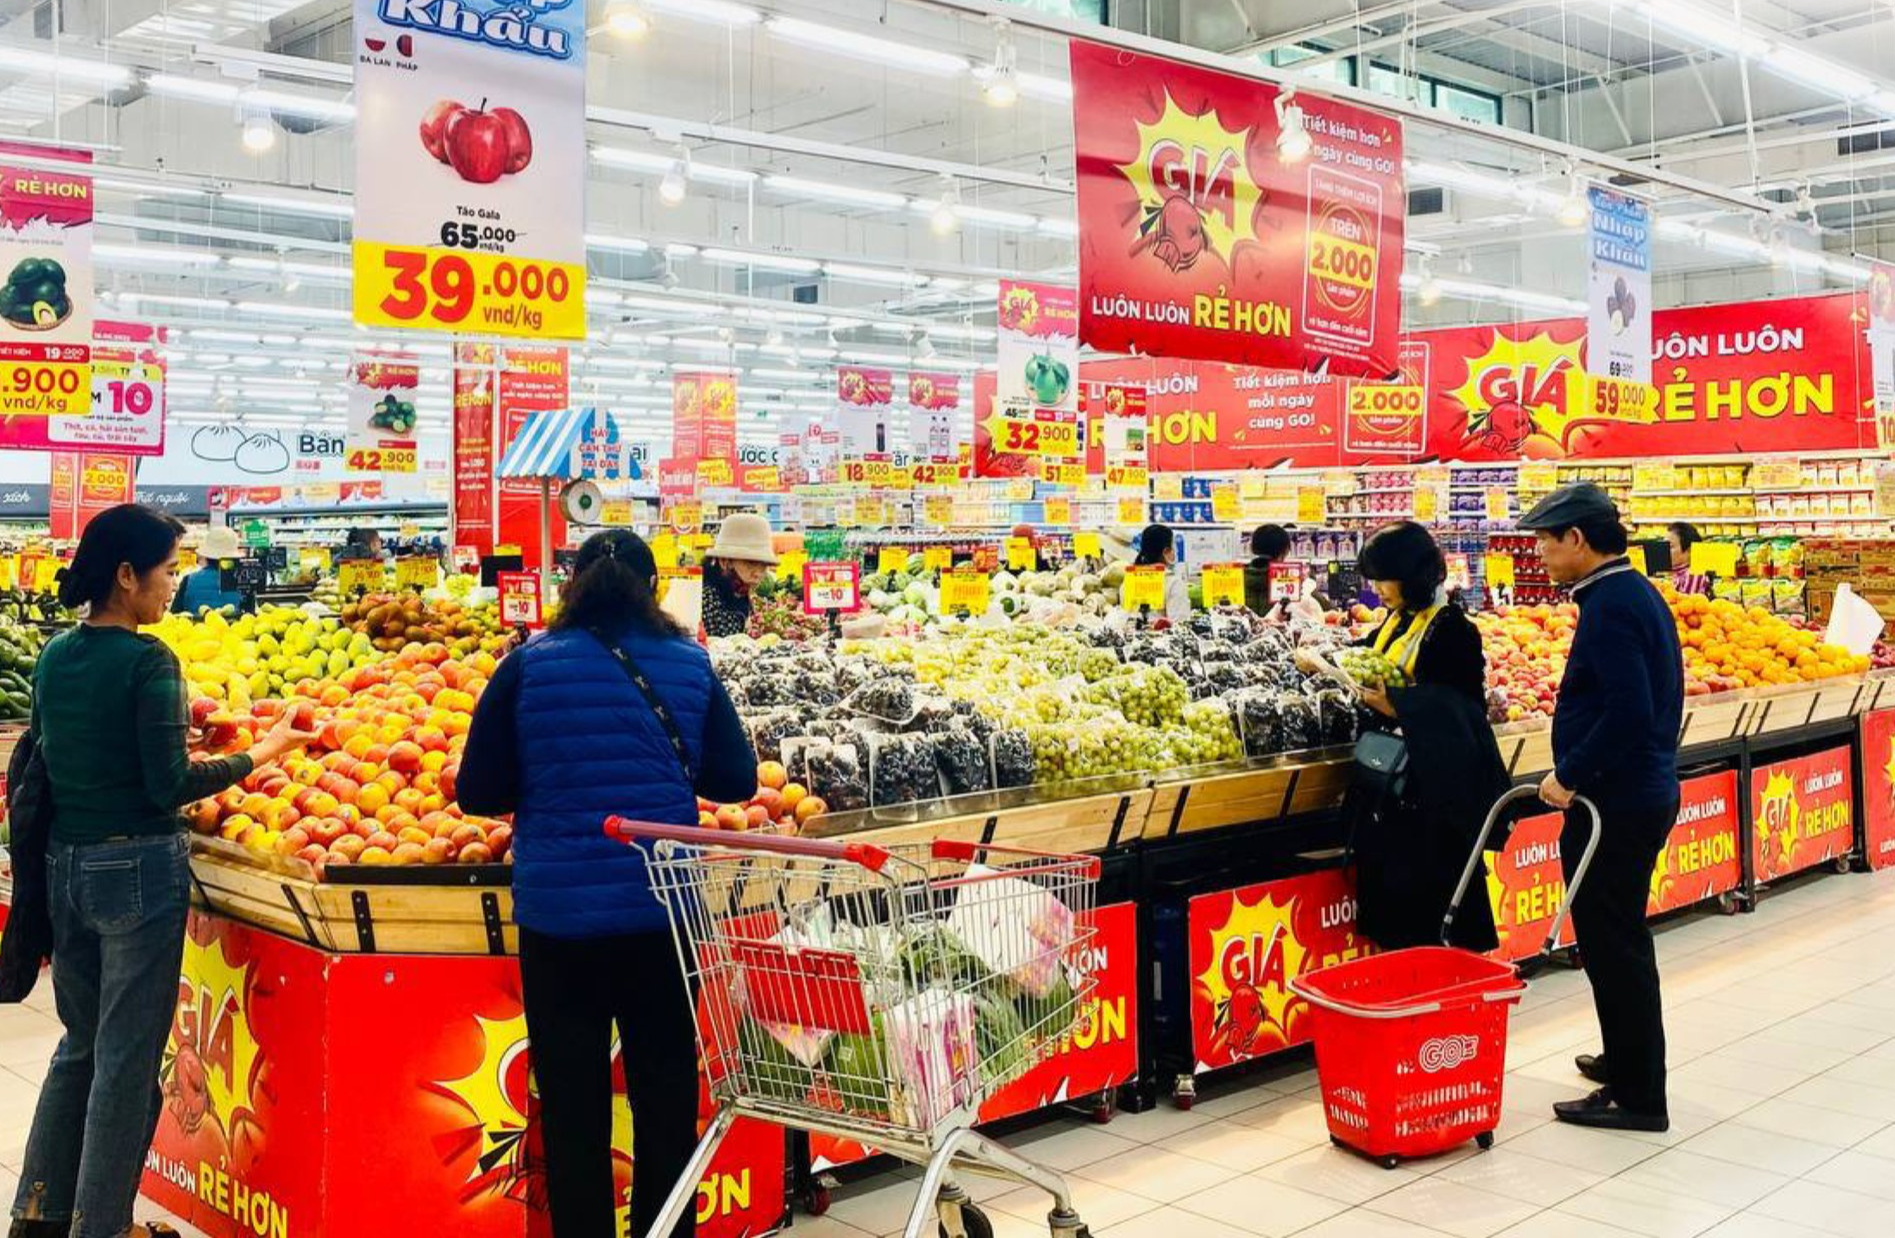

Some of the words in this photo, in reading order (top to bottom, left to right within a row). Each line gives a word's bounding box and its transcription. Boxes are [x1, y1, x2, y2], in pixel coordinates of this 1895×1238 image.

[1302, 113, 1327, 133] Tiết
[1329, 121, 1358, 142] kiệm
[1314, 145, 1343, 163] ngày
[44, 181, 87, 198] HƠN
[1149, 138, 1242, 232] GIÁ
[478, 208, 501, 220] Gala
[441, 221, 516, 249] 65.000
[1312, 241, 1373, 282] 2.000
[380, 249, 569, 323] 39.000
[482, 304, 542, 329] vnd/kg
[1092, 294, 1141, 320] LUÔN
[1145, 301, 1190, 325] LUÔN
[1194, 284, 1229, 330] RẺ
[1234, 300, 1291, 337] HƠN
[1651, 333, 1710, 361] UÔN
[1717, 324, 1804, 357] LUÔN
[1264, 372, 1299, 388] kiệm
[1477, 356, 1574, 416] GIÁ
[1706, 371, 1834, 420] HƠN
[2, 395, 68, 412] vnd/kg
[1279, 394, 1315, 409] ngày
[1352, 391, 1422, 411] 2.000
[1596, 381, 1645, 415] 59.000
[1005, 422, 1071, 451] 32.900
[1249, 415, 1284, 430] cùng
[1288, 413, 1316, 427] GO!
[349, 450, 415, 471] 42.900
[1822, 799, 1849, 833] HƠN
[1515, 841, 1548, 869] LUÔN
[1678, 827, 1700, 875] RẺ
[1700, 830, 1735, 868] HƠN
[1515, 873, 1543, 925] RẺ
[1220, 921, 1288, 994] GIÁ
[162, 1155, 196, 1194] LUÔN
[200, 1155, 229, 1215] RẺ
[233, 1179, 288, 1238] HƠN
[697, 1168, 750, 1224] ƠN
